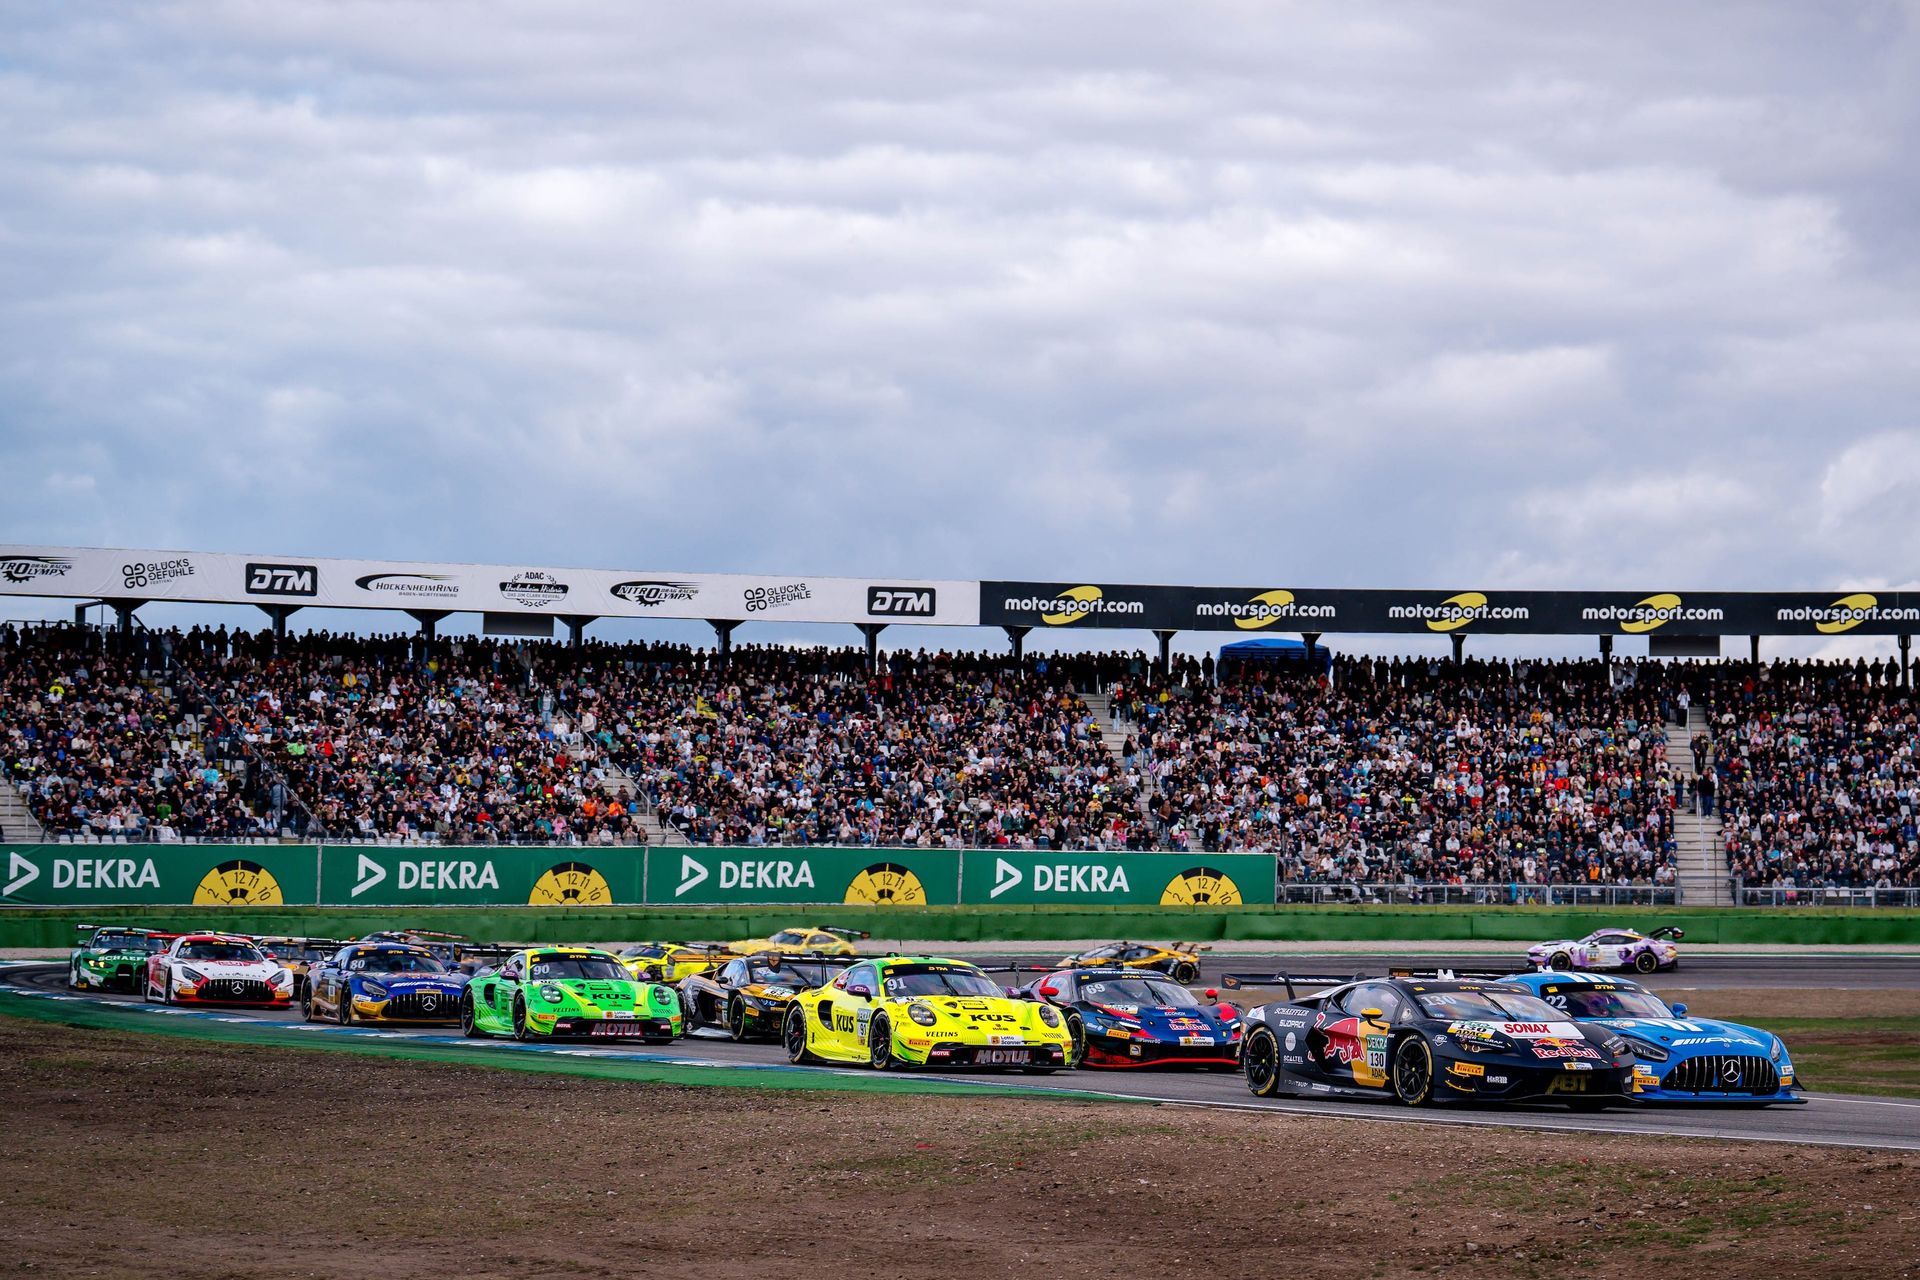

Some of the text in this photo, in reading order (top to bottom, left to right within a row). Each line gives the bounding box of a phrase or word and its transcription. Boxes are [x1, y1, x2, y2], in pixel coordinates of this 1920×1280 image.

[147, 559, 189, 571] GLÜCKS
[148, 566, 195, 580] GEFÜHLE
[250, 568, 312, 591] DTM
[766, 583, 806, 596] GLÜCKS
[768, 590, 811, 604] GEFÜHLE
[872, 592, 930, 612] DTM
[1005, 598, 1144, 616] motorsport.com
[1196, 602, 1336, 620] motorsport.com
[1388, 605, 1528, 622] motorsport.com
[1583, 606, 1723, 624] motorsport.com
[1778, 606, 1919, 623] motorsport.com
[53, 858, 160, 888] DEKRA
[398, 860, 500, 889] DEKRA
[720, 860, 814, 888] DEKRA
[1034, 865, 1130, 892] DEKRA
[208, 872, 271, 901] 2 1 12 11 10
[542, 872, 601, 900] 2 1 12 11 10
[857, 872, 916, 901] 2 1 12 11 10
[1172, 877, 1232, 904] 2 1 12 11 10
[179, 948, 192, 956] 84
[350, 960, 365, 970] 80
[534, 964, 550, 975] 90
[887, 978, 906, 990] 91
[1086, 984, 1105, 994] 69
[1421, 995, 1456, 1006] 130
[1546, 995, 1568, 1009] 22
[1274, 1008, 1310, 1016] SCHAEFFLER
[591, 1023, 640, 1036] MOTUL
[1504, 1024, 1551, 1033] SONAX
[975, 1050, 1031, 1063] MOTUL
[1370, 1052, 1384, 1067] 130
[1532, 1046, 1602, 1059] Red Bull
[1457, 1064, 1481, 1073] PIRELLI
